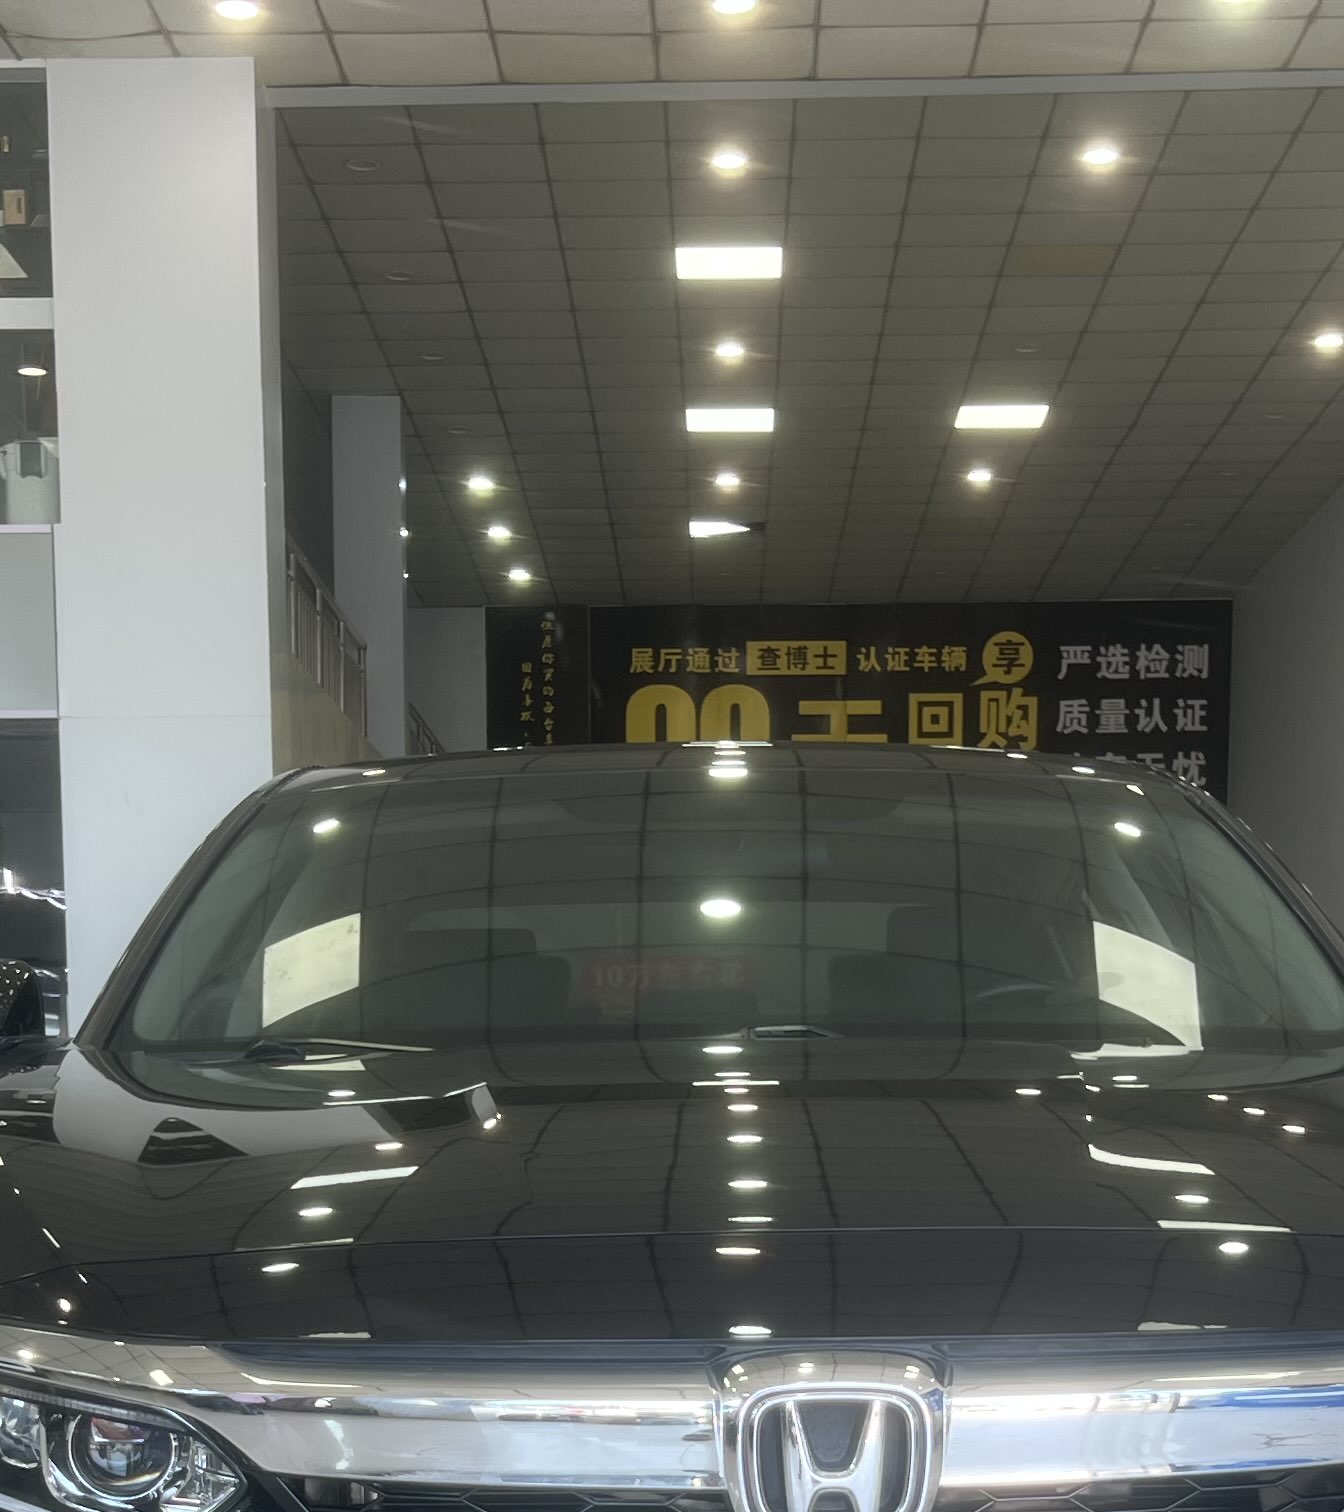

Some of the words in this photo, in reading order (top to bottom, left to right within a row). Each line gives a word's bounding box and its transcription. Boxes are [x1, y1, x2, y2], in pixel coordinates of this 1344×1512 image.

[629, 647, 741, 673] 展厅通过
[756, 644, 838, 671] 查博士
[856, 645, 968, 673] 认证车辆
[991, 639, 1027, 676] 享
[1056, 643, 1210, 680] 严选检测
[1055, 697, 1209, 735] 质量认证
